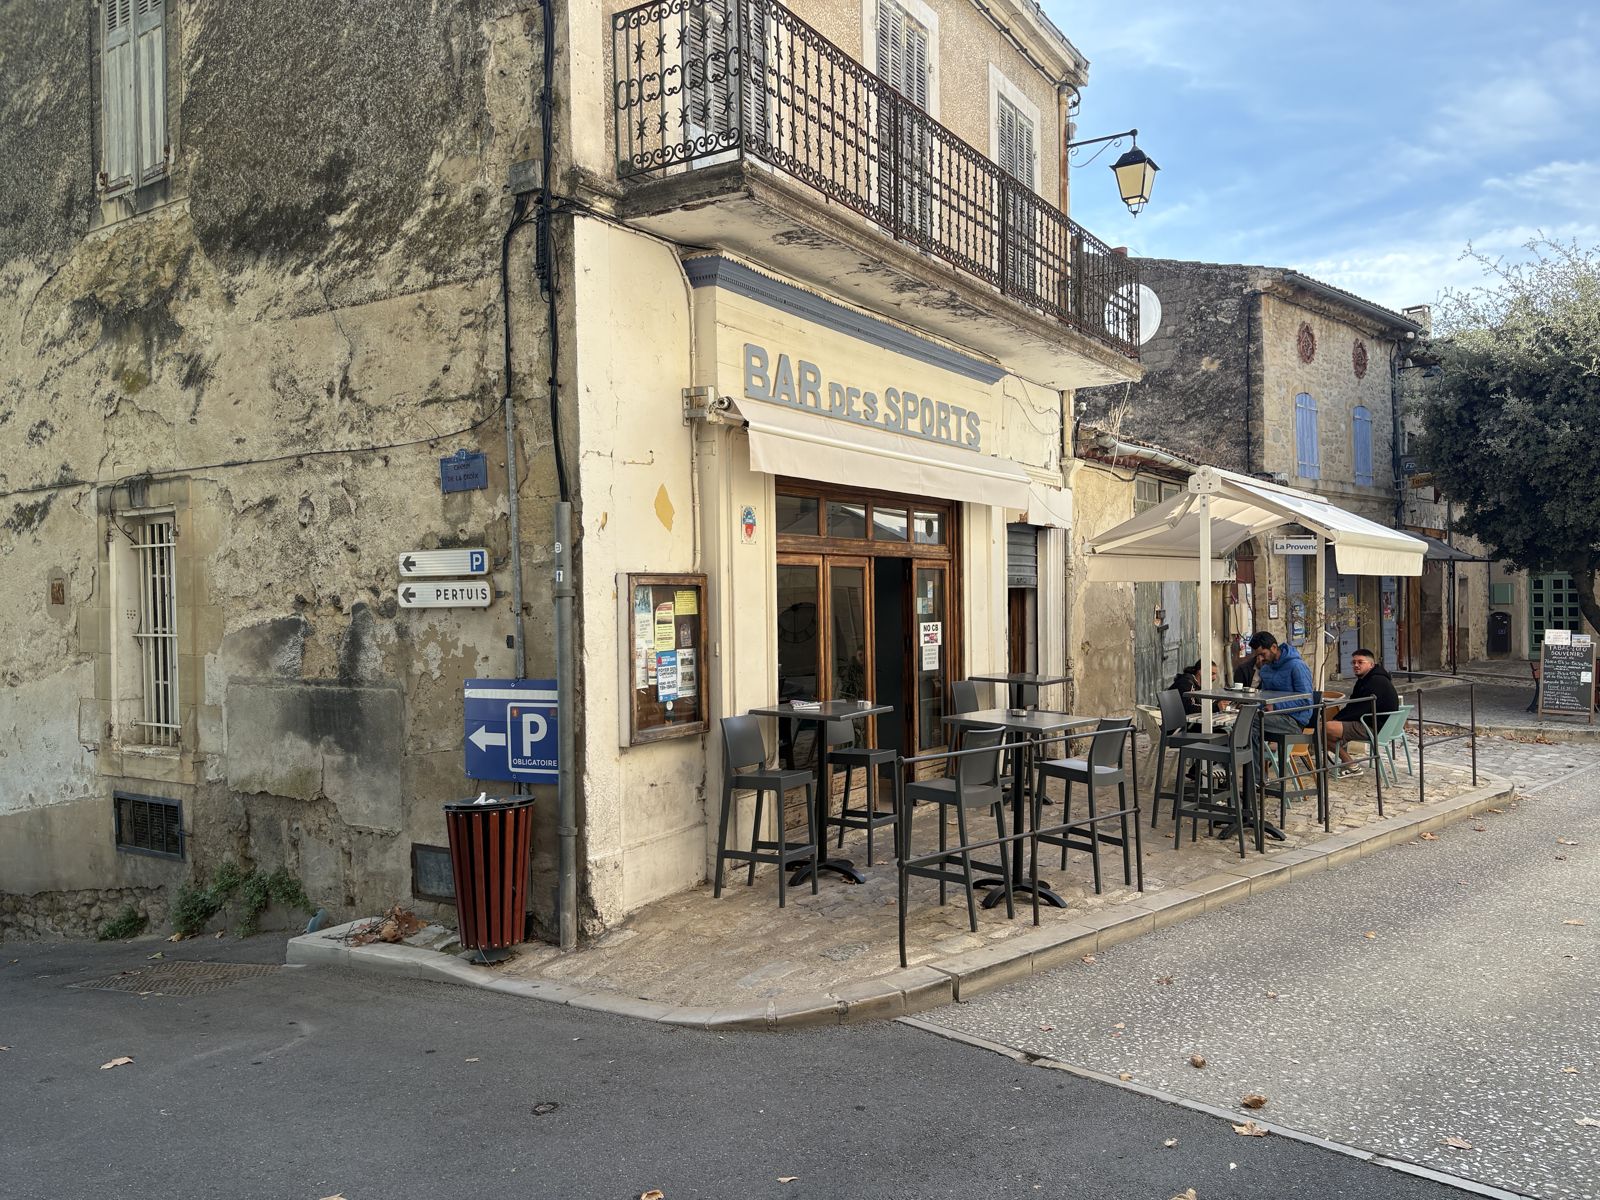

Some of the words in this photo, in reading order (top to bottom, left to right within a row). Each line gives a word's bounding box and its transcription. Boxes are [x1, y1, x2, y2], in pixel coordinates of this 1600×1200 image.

[743, 343, 821, 409] BAR
[828, 382, 878, 422] DES
[884, 387, 981, 448] SPORTS
[472, 553, 482, 571] P
[435, 588, 488, 601] PERTUIS
[932, 624, 938, 632] CB
[1551, 650, 1584, 658] SOUVENIRS
[522, 712, 548, 757] P
[512, 758, 558, 767] OBLIGATOIRE
